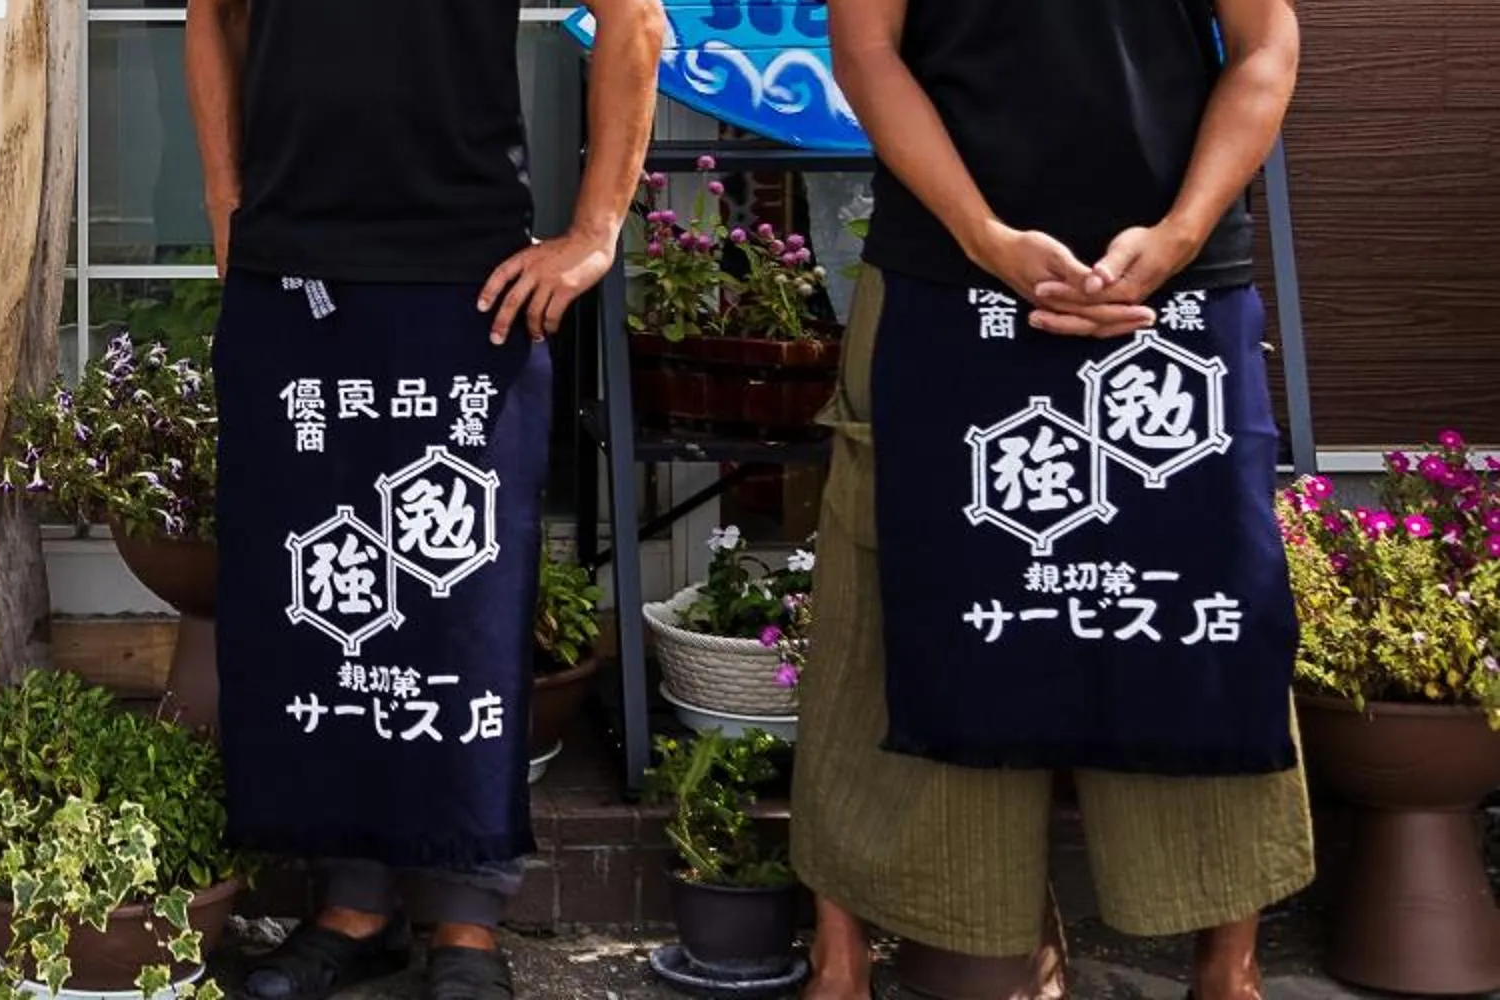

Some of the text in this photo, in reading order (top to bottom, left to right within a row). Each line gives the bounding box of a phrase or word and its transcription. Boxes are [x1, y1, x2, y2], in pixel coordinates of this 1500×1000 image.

[1023, 561, 1180, 595] 親切第一
[337, 661, 460, 697] 親切第一
